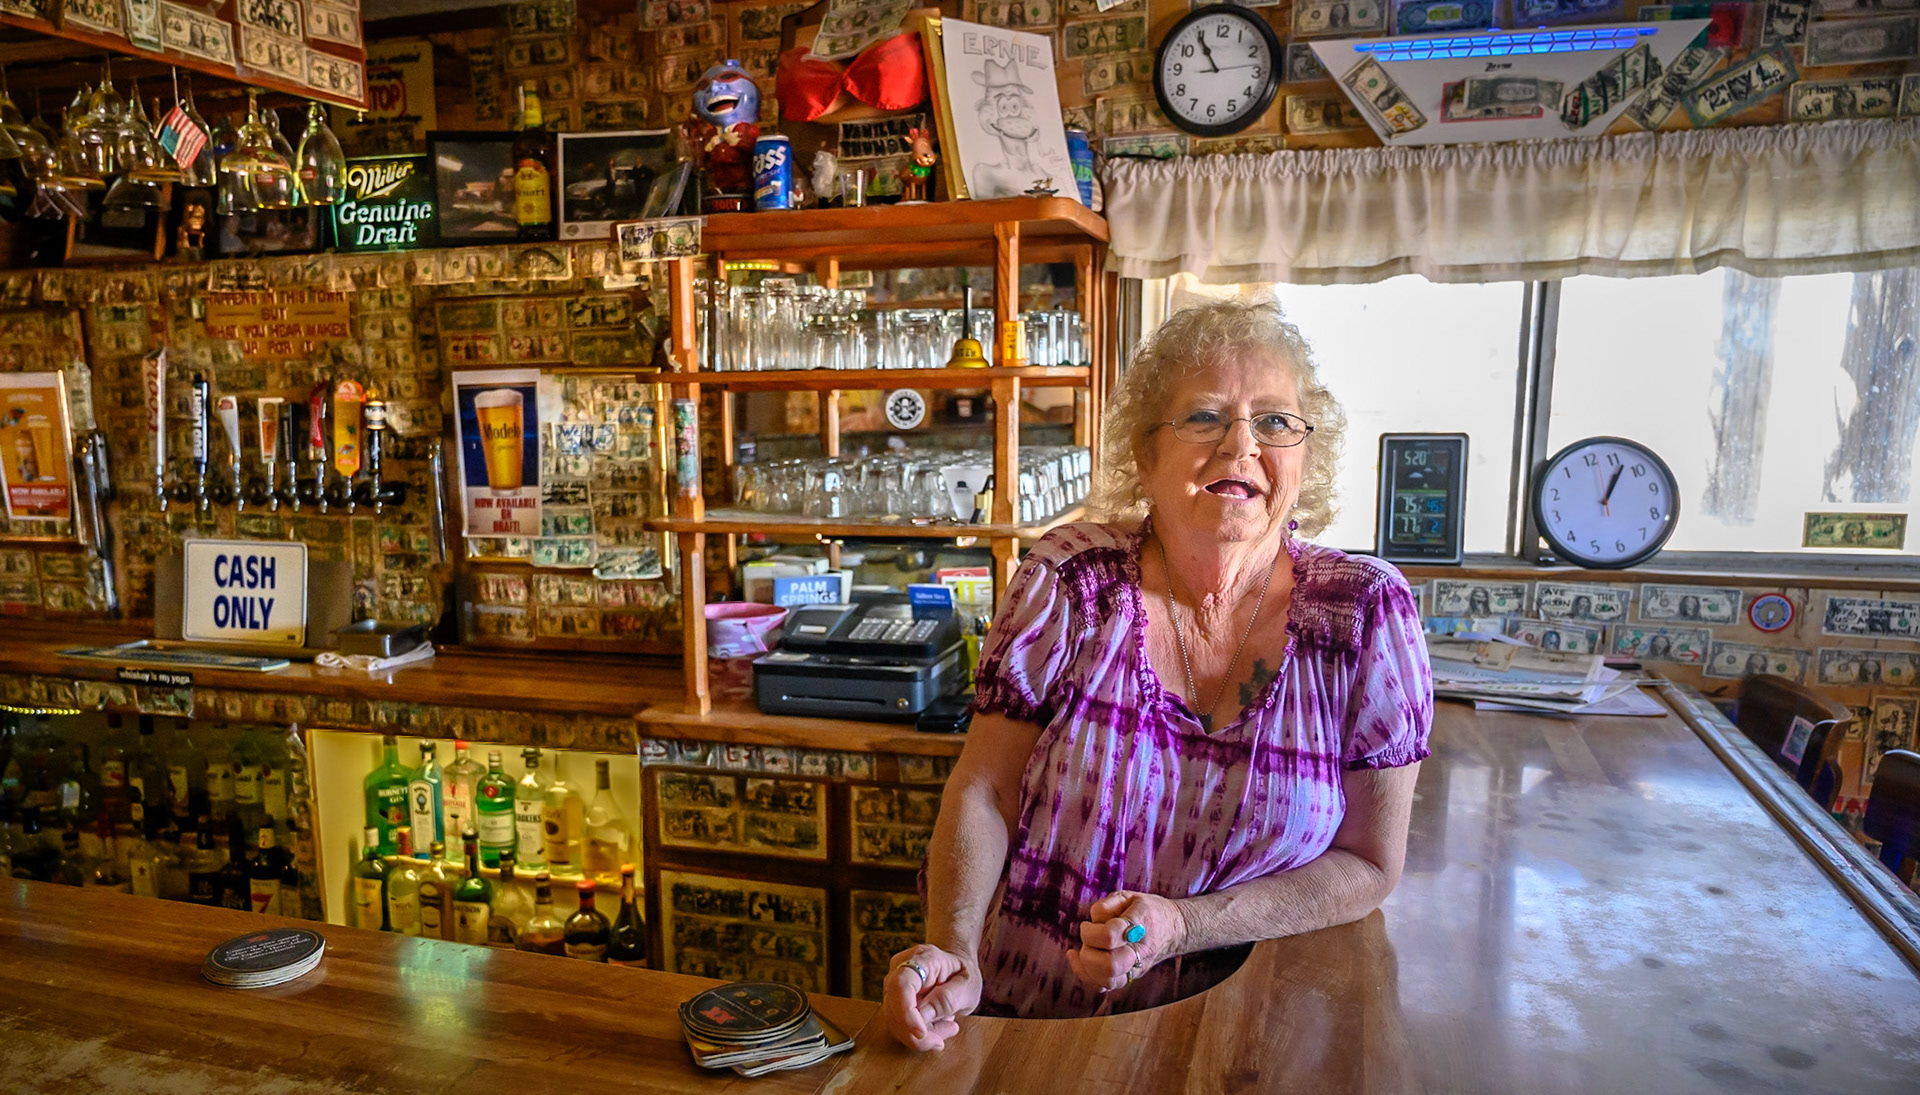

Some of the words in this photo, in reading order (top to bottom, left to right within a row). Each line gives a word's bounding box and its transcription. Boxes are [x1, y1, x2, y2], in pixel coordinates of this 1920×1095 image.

[1216, 25, 1230, 38] 12
[1238, 30, 1242, 43] 1
[963, 32, 1048, 70] ERNIE
[1181, 44, 1194, 57] 10
[1248, 45, 1258, 58] 2
[1173, 63, 1182, 76] 9
[1251, 66, 1260, 79] 3
[1175, 84, 1186, 96] 8
[1243, 85, 1252, 99] 4
[369, 84, 400, 112] TOP
[1189, 98, 1198, 111] 7
[1206, 104, 1216, 117] 6
[1226, 99, 1236, 112] 5
[348, 161, 414, 199] Miller
[339, 198, 433, 225] Genuine
[356, 221, 418, 245] Draft
[261, 307, 288, 321] BUT
[206, 325, 239, 338] WHAT
[243, 325, 268, 338] YOU
[271, 324, 305, 337] HEAR
[307, 323, 350, 337] MAKES
[1582, 453, 1598, 467] 12
[1606, 452, 1620, 466] 11
[1564, 466, 1571, 479] 1
[1630, 463, 1646, 478] 10
[1550, 488, 1560, 501] 2
[1649, 482, 1659, 495] 9
[475, 498, 493, 508] NOW
[496, 498, 536, 508] AVAILABLE
[1552, 510, 1561, 523] 3
[1649, 507, 1660, 520] 8
[1566, 530, 1576, 542] 4
[1638, 527, 1647, 540] 7
[1590, 540, 1600, 554] 5
[1615, 540, 1625, 553] 6
[214, 554, 276, 589] CASH
[790, 581, 827, 593] PALM
[781, 591, 837, 606] SPRINGS
[213, 595, 275, 630] ONLY
[119, 670, 150, 683] whiskey
[151, 672, 157, 681] is
[159, 674, 170, 684] my
[171, 675, 191, 685] yoga
